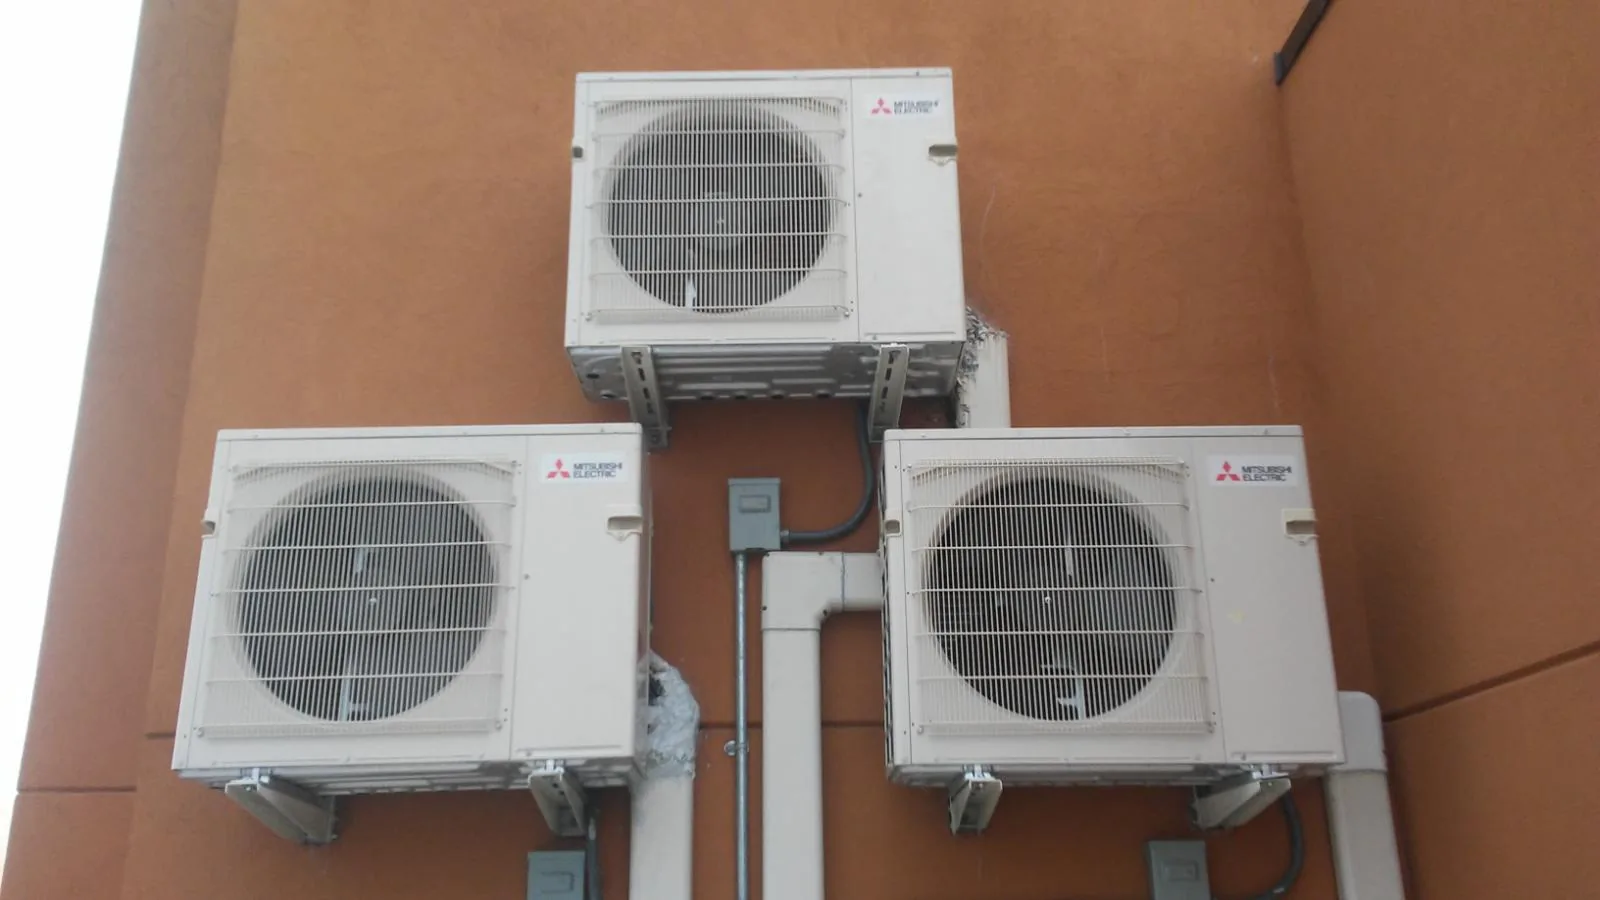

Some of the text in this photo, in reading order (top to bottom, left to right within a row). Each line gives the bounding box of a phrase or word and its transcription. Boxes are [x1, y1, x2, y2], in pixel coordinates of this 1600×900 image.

[573, 462, 622, 470] MITSUBISHI
[1241, 465, 1292, 473] MITSUBISHI
[573, 470, 616, 479] ELECTRIC
[1242, 473, 1287, 482] ELECTRIC
